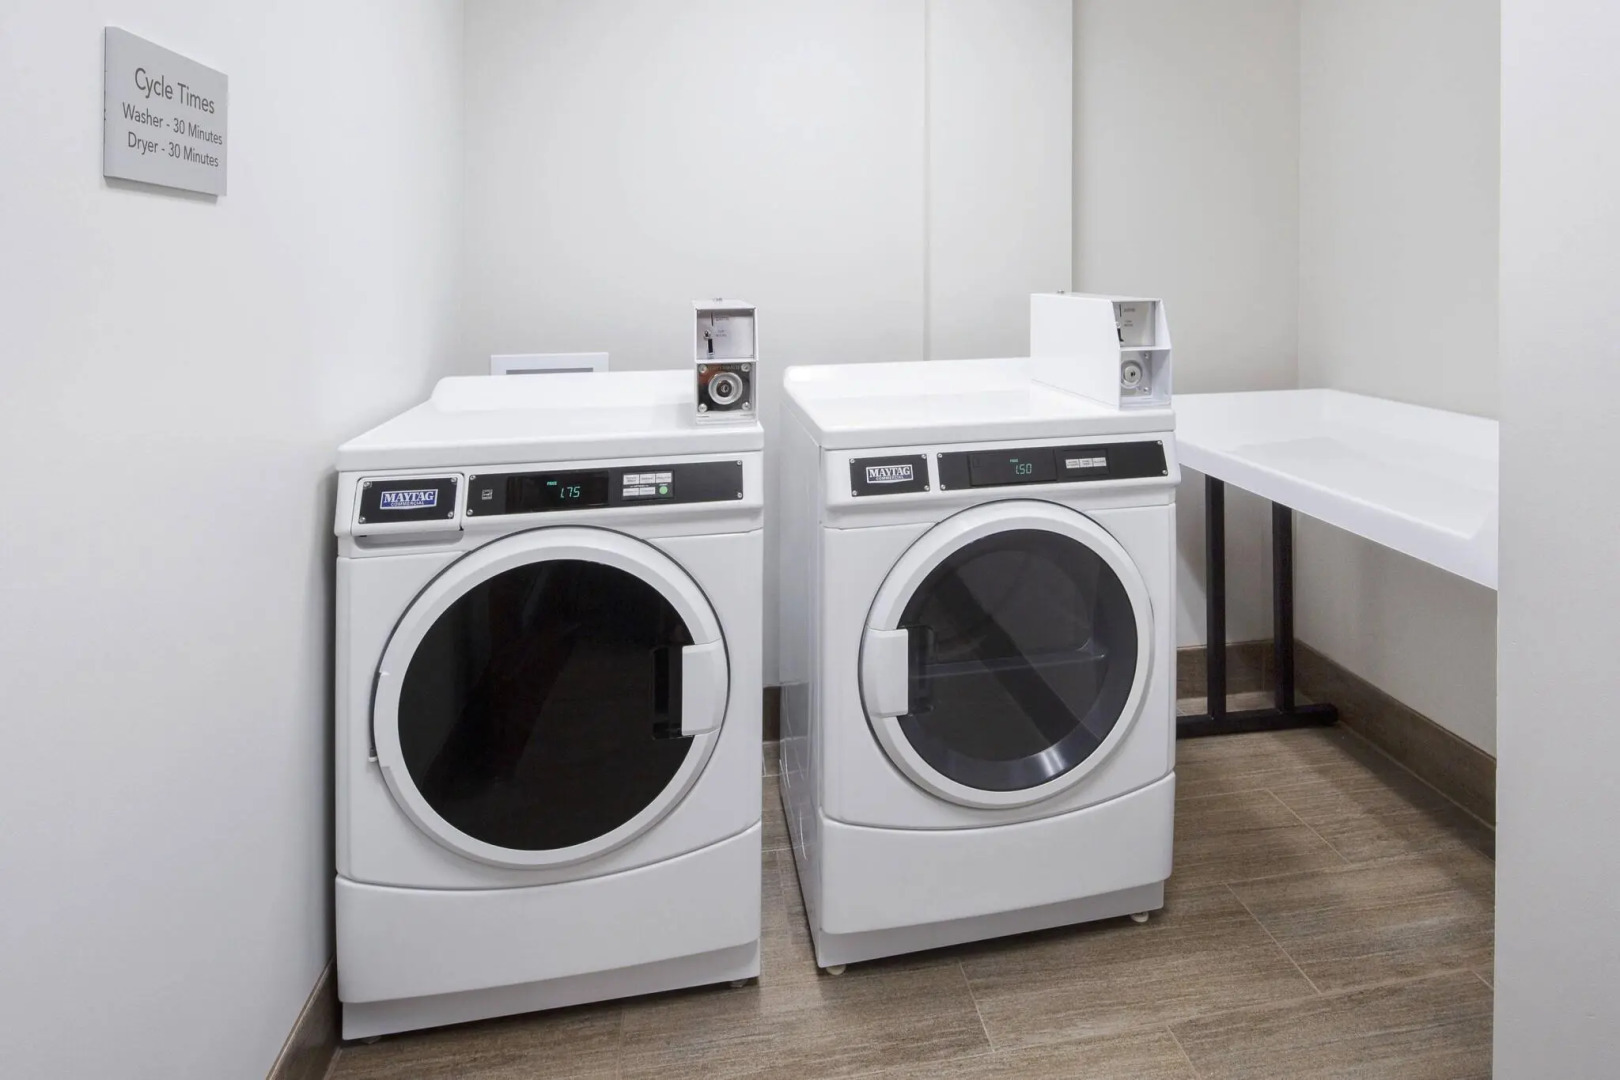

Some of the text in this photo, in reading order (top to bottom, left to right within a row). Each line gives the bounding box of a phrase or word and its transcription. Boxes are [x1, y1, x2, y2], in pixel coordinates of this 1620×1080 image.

[135, 67, 215, 114] Cycle Times
[122, 101, 164, 128] Washer
[173, 117, 186, 135] 30
[188, 122, 223, 145] Minutes
[128, 131, 159, 155] Dryer
[168, 141, 181, 159] 30
[183, 145, 219, 168] Minutes
[869, 466, 910, 478] MAYTAG
[383, 491, 435, 503] MAYTAG
